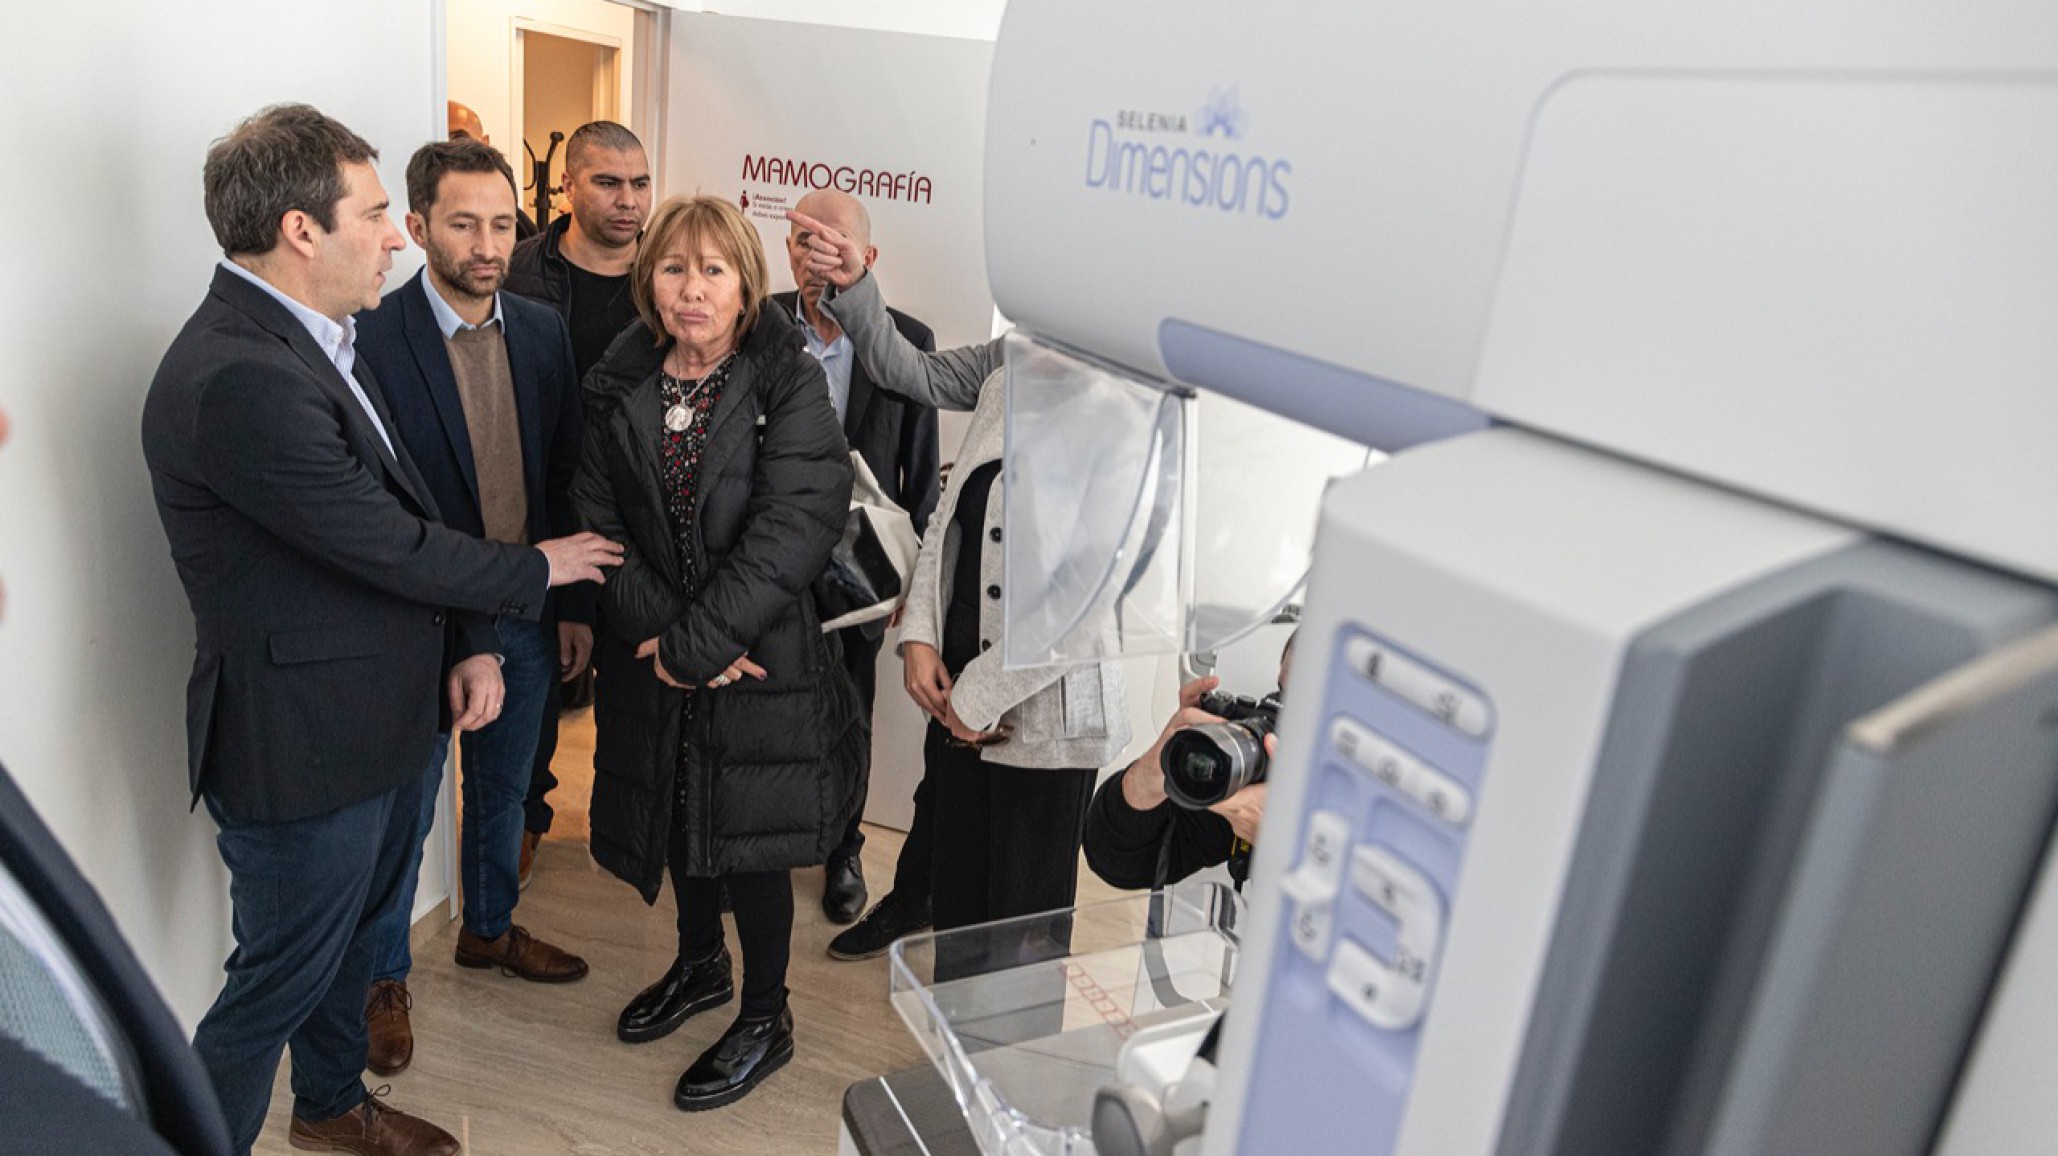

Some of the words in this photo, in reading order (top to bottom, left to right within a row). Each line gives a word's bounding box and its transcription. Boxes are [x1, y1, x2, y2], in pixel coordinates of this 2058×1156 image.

[1117, 109, 1188, 133] SELENIA
[742, 154, 932, 204] MAMOGRAFÍA
[1086, 118, 1292, 220] Dimensions
